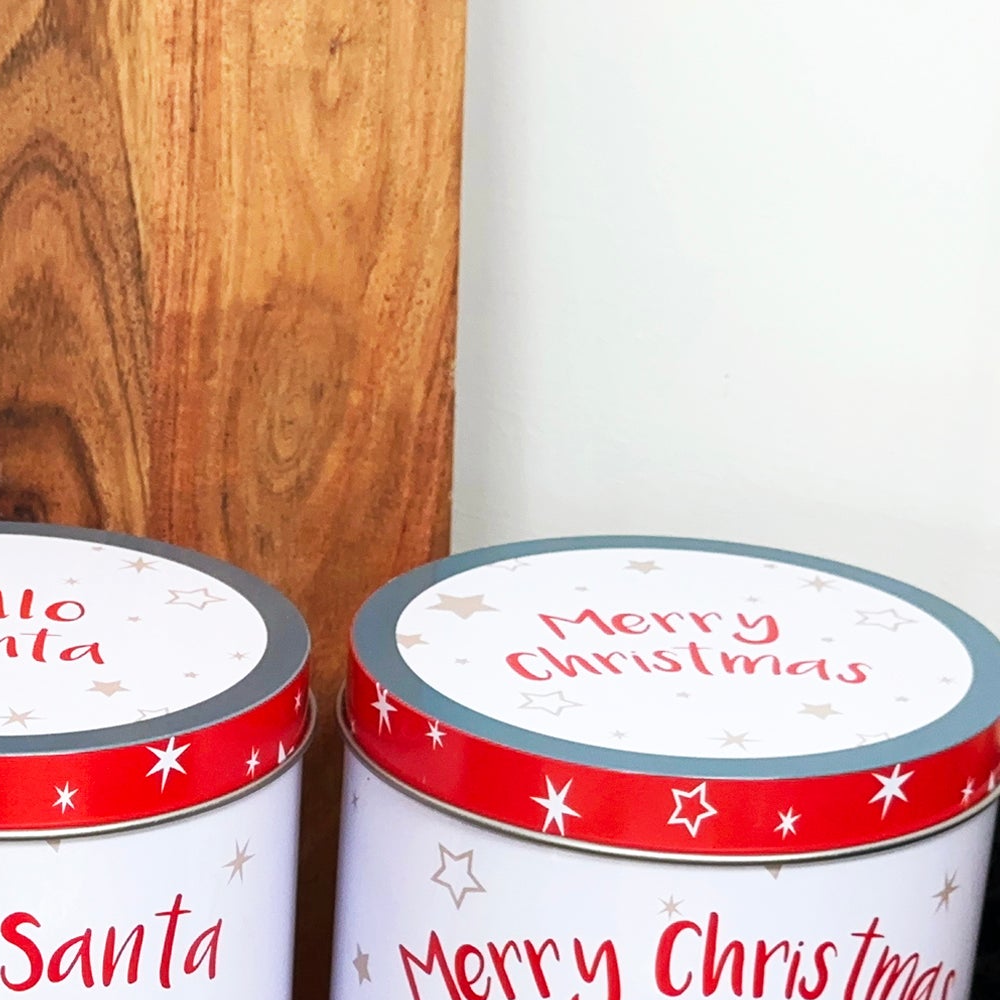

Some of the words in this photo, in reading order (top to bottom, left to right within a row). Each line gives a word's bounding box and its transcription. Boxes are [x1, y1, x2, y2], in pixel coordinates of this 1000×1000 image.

[537, 608, 780, 645] Merry
[505, 641, 872, 684] Christmas
[0, 893, 223, 993] Santa
